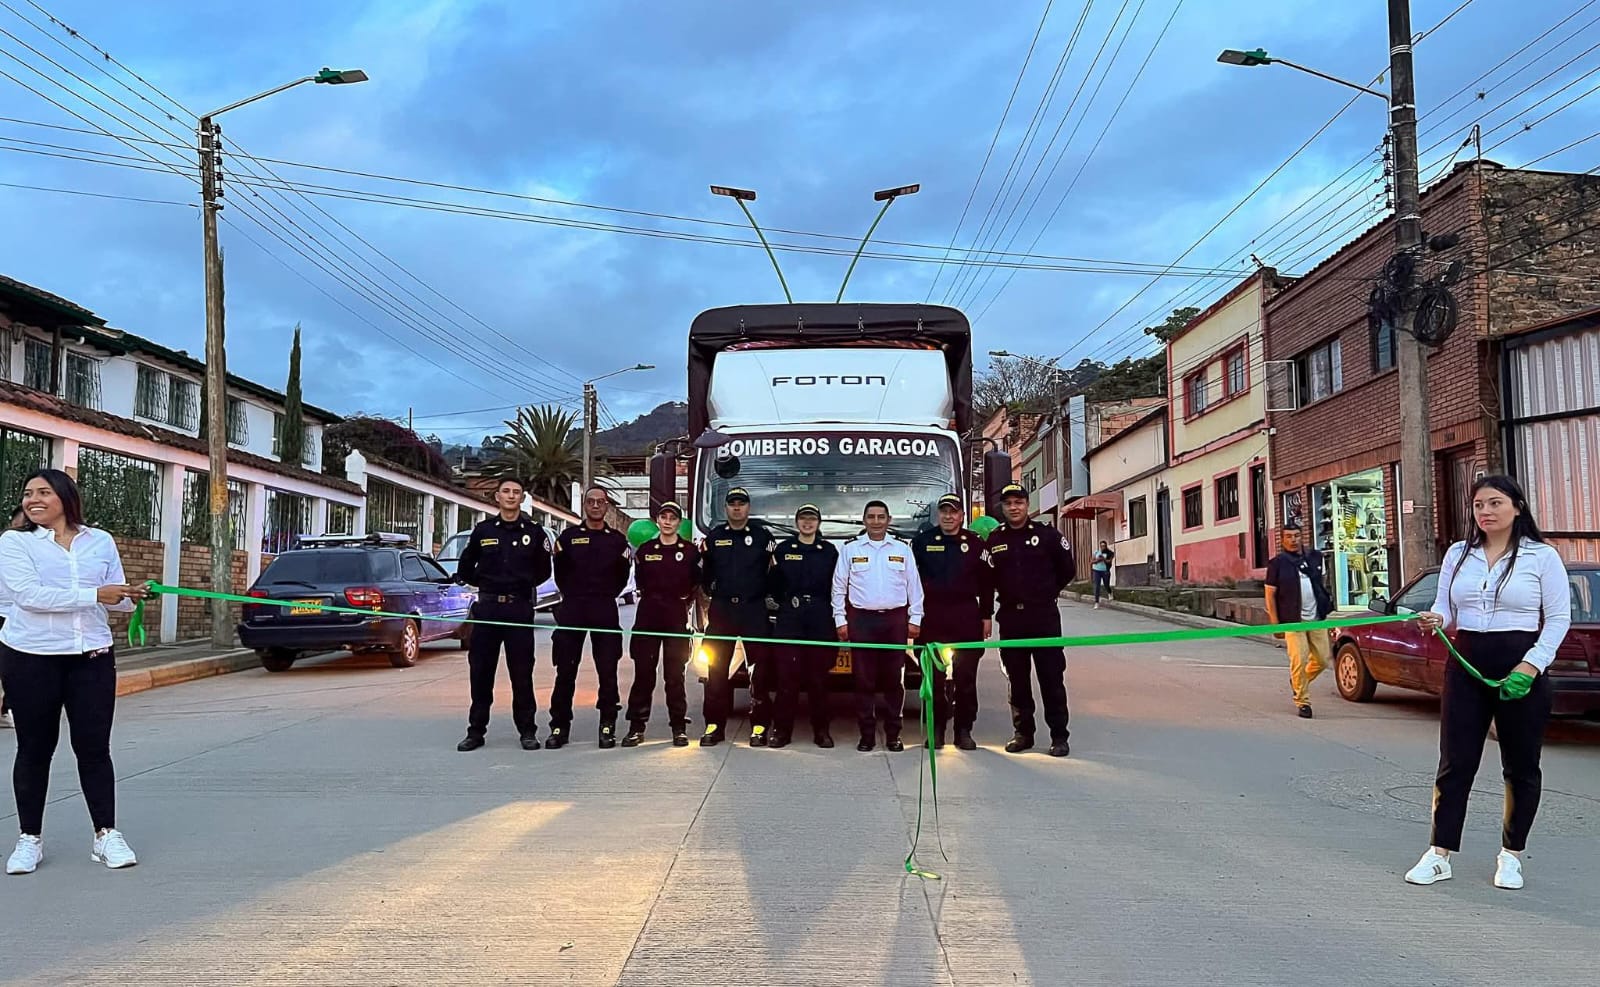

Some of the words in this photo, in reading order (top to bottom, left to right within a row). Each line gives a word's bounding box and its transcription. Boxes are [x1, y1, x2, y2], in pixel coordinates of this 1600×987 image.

[772, 375, 886, 386] FOTON
[717, 438, 830, 457] BOMBEROS
[839, 438, 940, 456] GARAGOA
